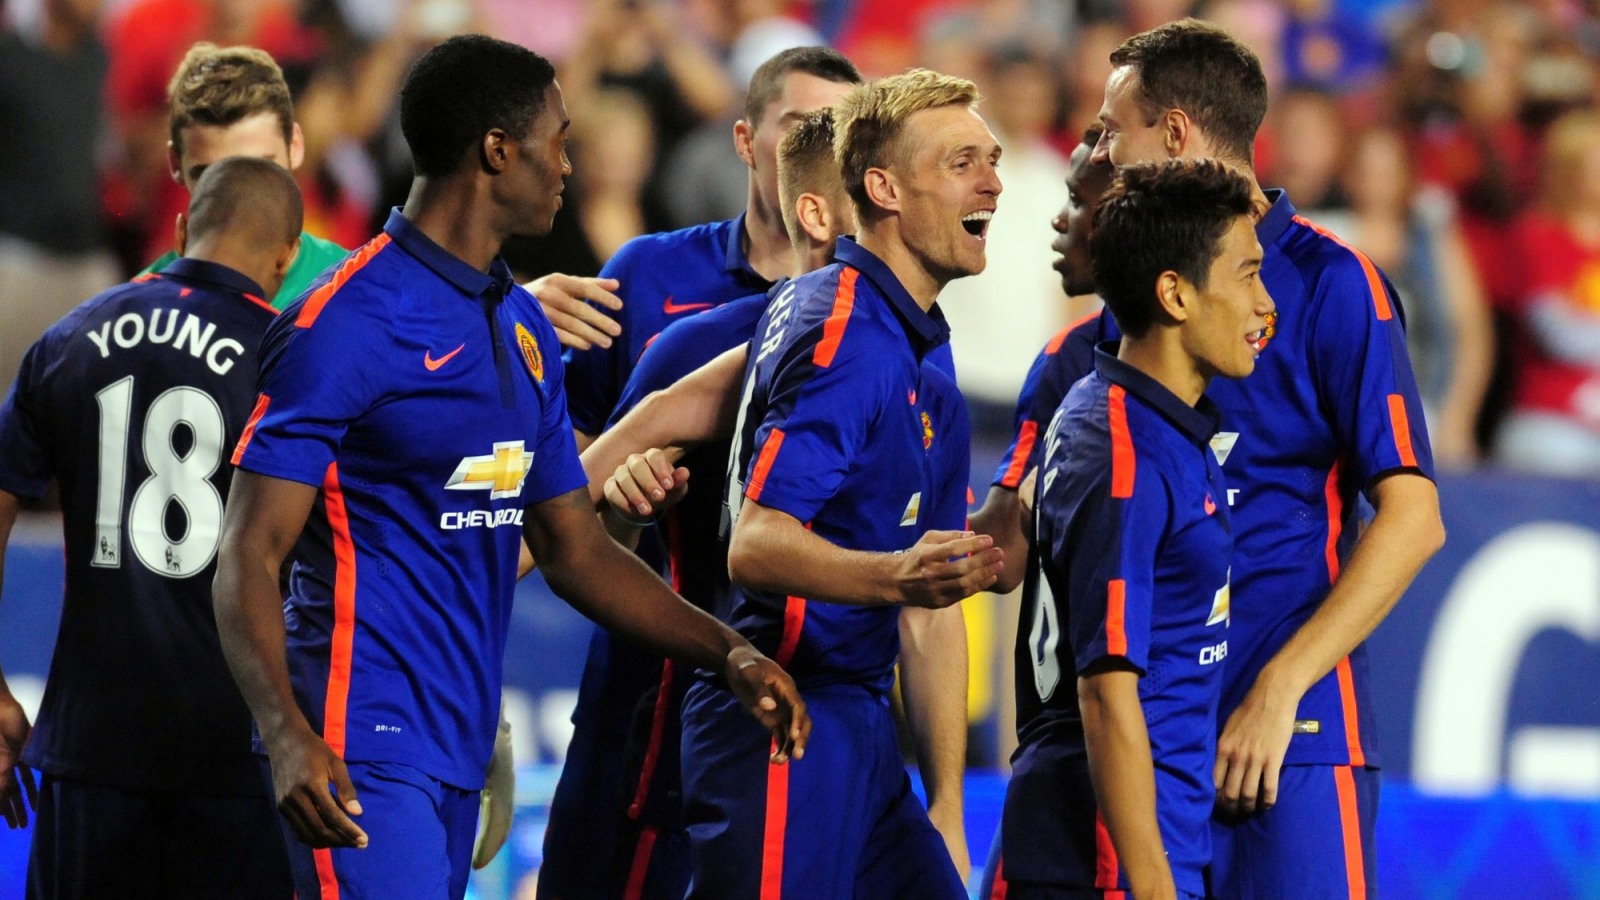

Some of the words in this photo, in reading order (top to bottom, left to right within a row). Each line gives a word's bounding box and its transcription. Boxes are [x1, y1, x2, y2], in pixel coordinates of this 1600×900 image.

[87, 308, 245, 376] YOUNG
[91, 375, 225, 578] 18
[375, 724, 402, 734] DRI-FIT
